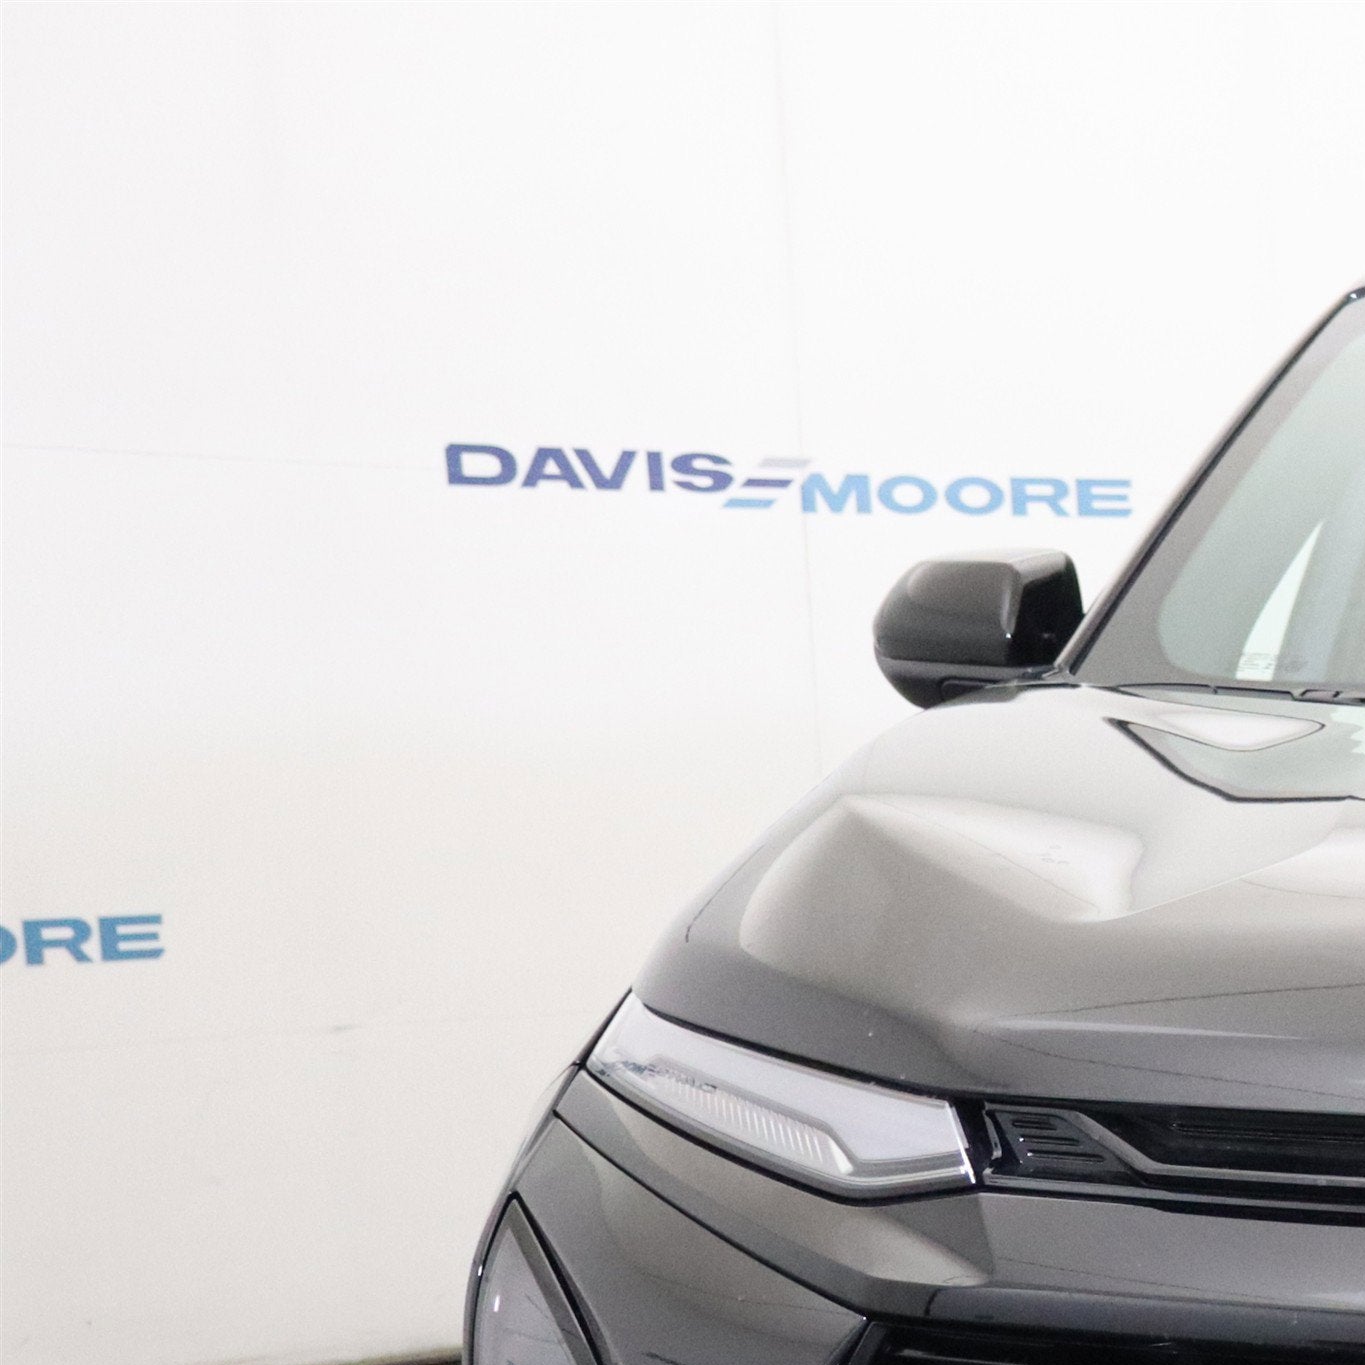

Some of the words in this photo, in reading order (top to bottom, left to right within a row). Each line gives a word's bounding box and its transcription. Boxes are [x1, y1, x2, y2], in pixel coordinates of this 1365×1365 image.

[445, 443, 735, 494] DAVIS
[801, 472, 1133, 518] MOORE
[0, 914, 165, 966] RE
